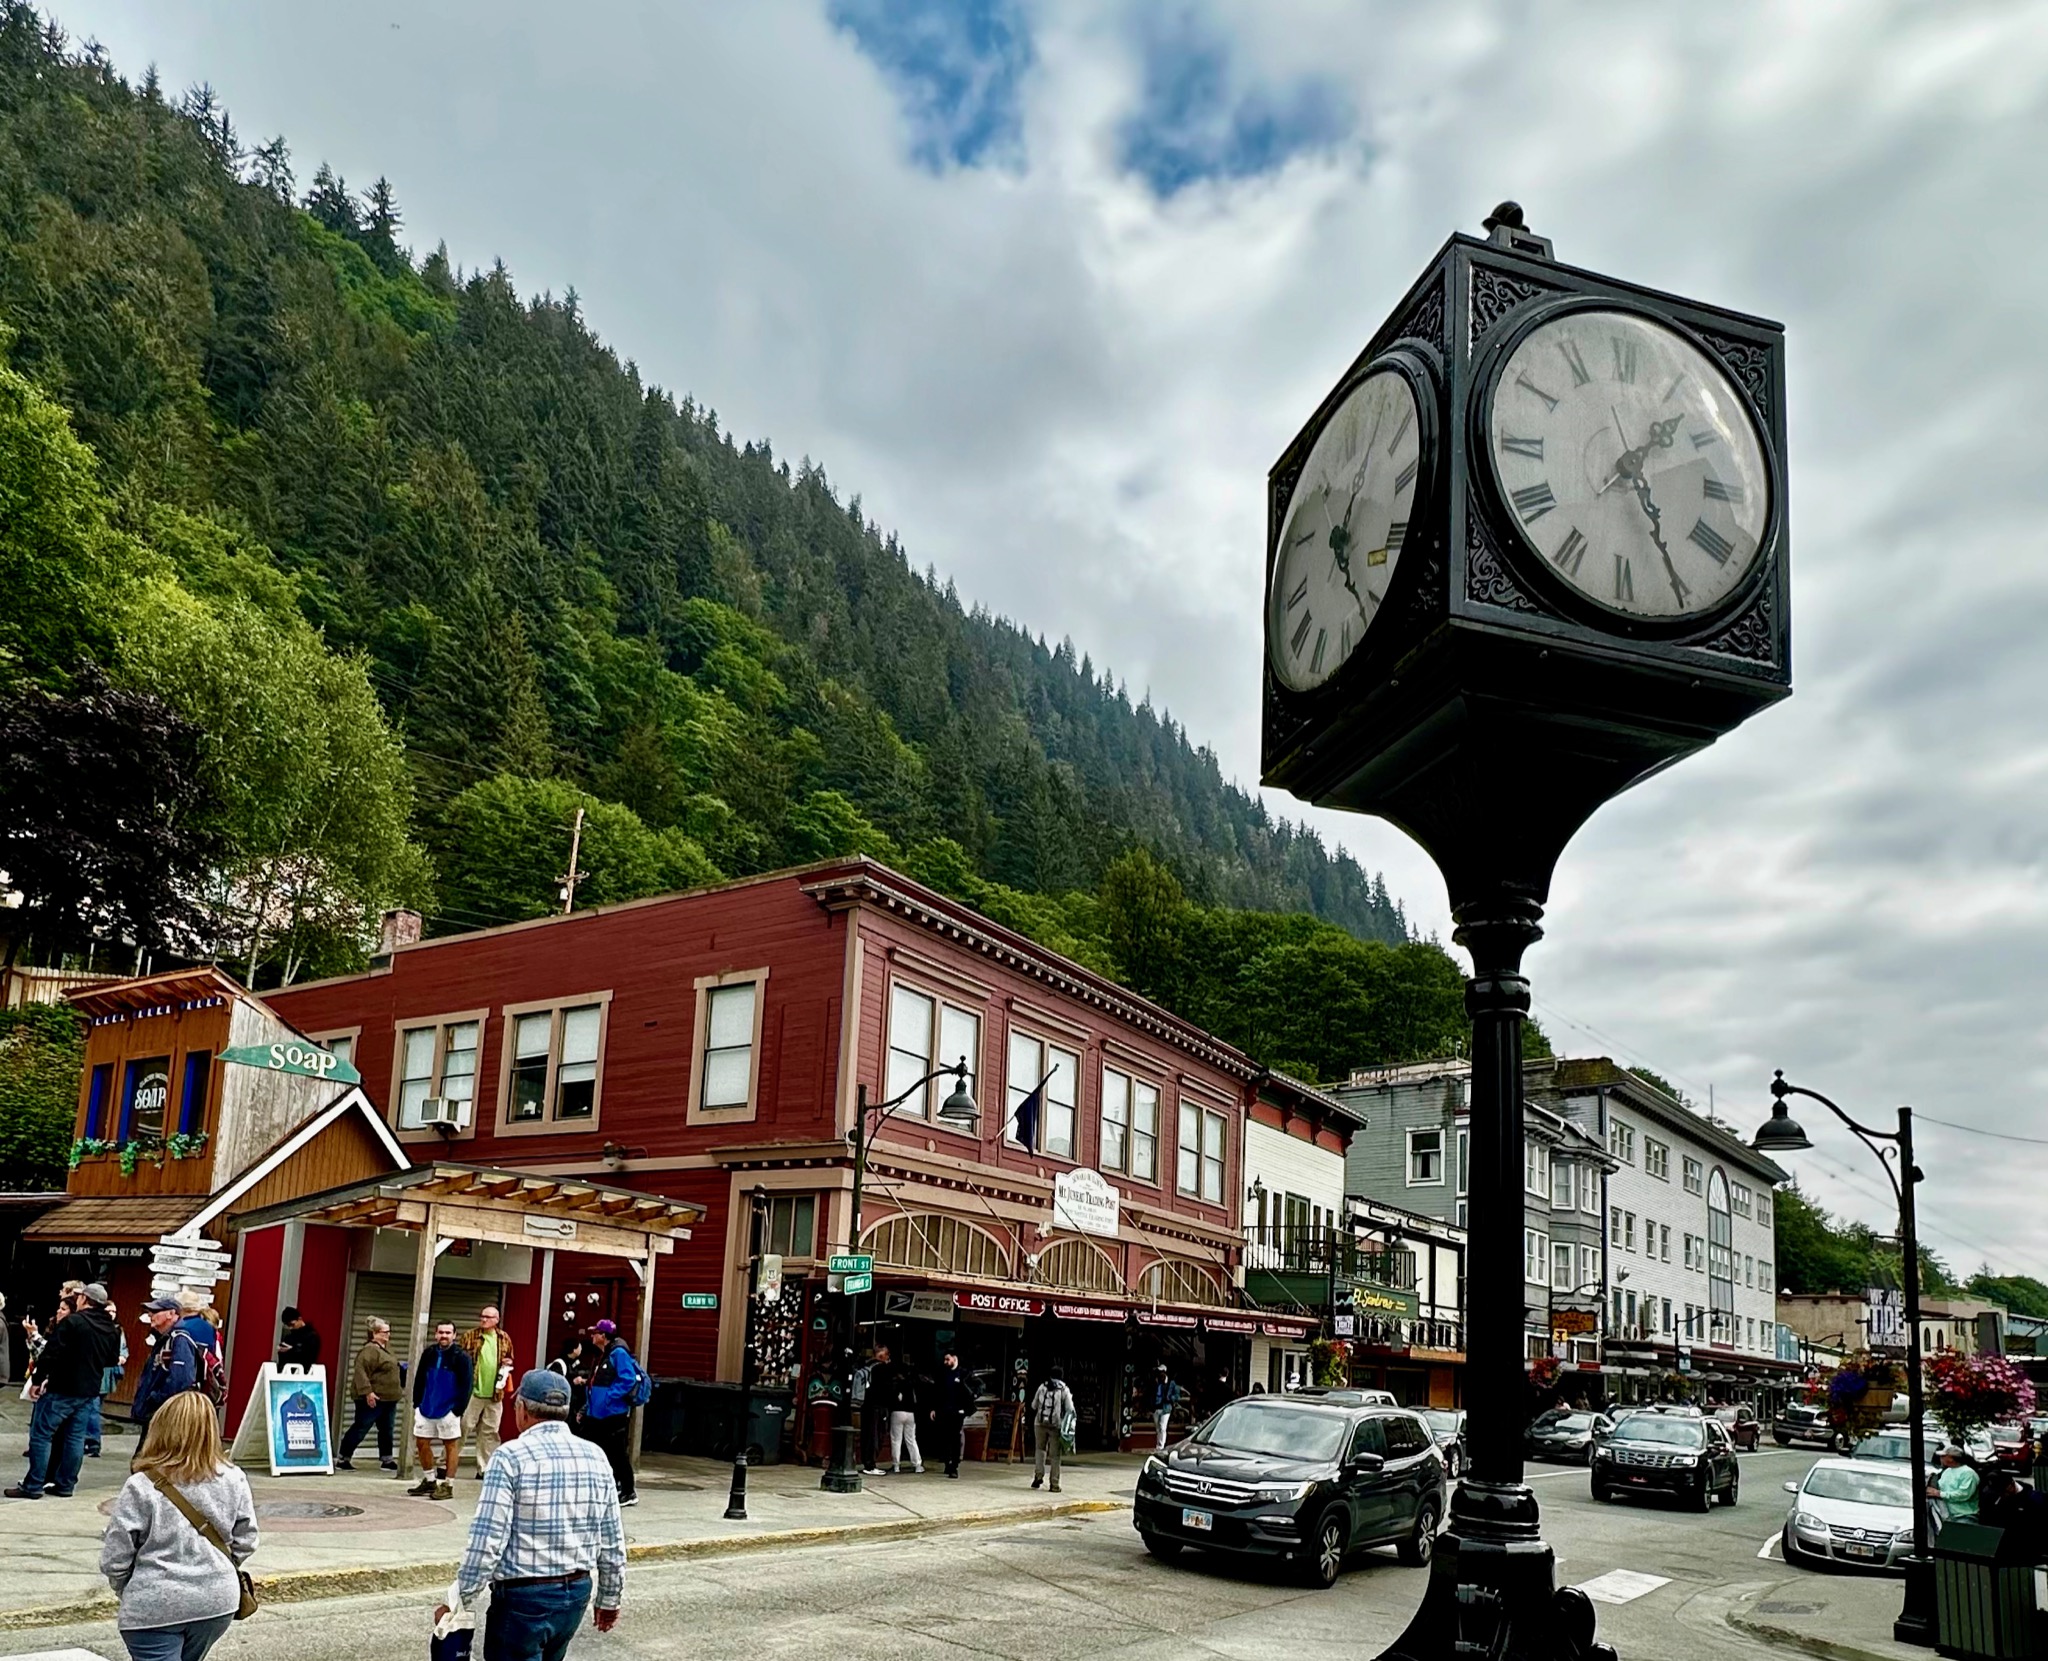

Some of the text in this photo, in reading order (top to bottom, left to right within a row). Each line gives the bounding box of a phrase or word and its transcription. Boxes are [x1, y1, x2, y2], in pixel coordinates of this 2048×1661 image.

[1514, 367, 1560, 413] X
[1501, 427, 1544, 464] IX
[1509, 479, 1557, 528] VIII
[1552, 525, 1589, 578] VII
[1614, 553, 1635, 601] VI
[268, 1043, 338, 1079] Soap
[134, 1086, 167, 1110] SOAP
[832, 1258, 870, 1269] FRONT ST
[971, 1294, 1031, 1312] POST OFFICE
[1869, 1287, 1904, 1307] WE ARE
[1870, 1304, 1905, 1334] TIDE
